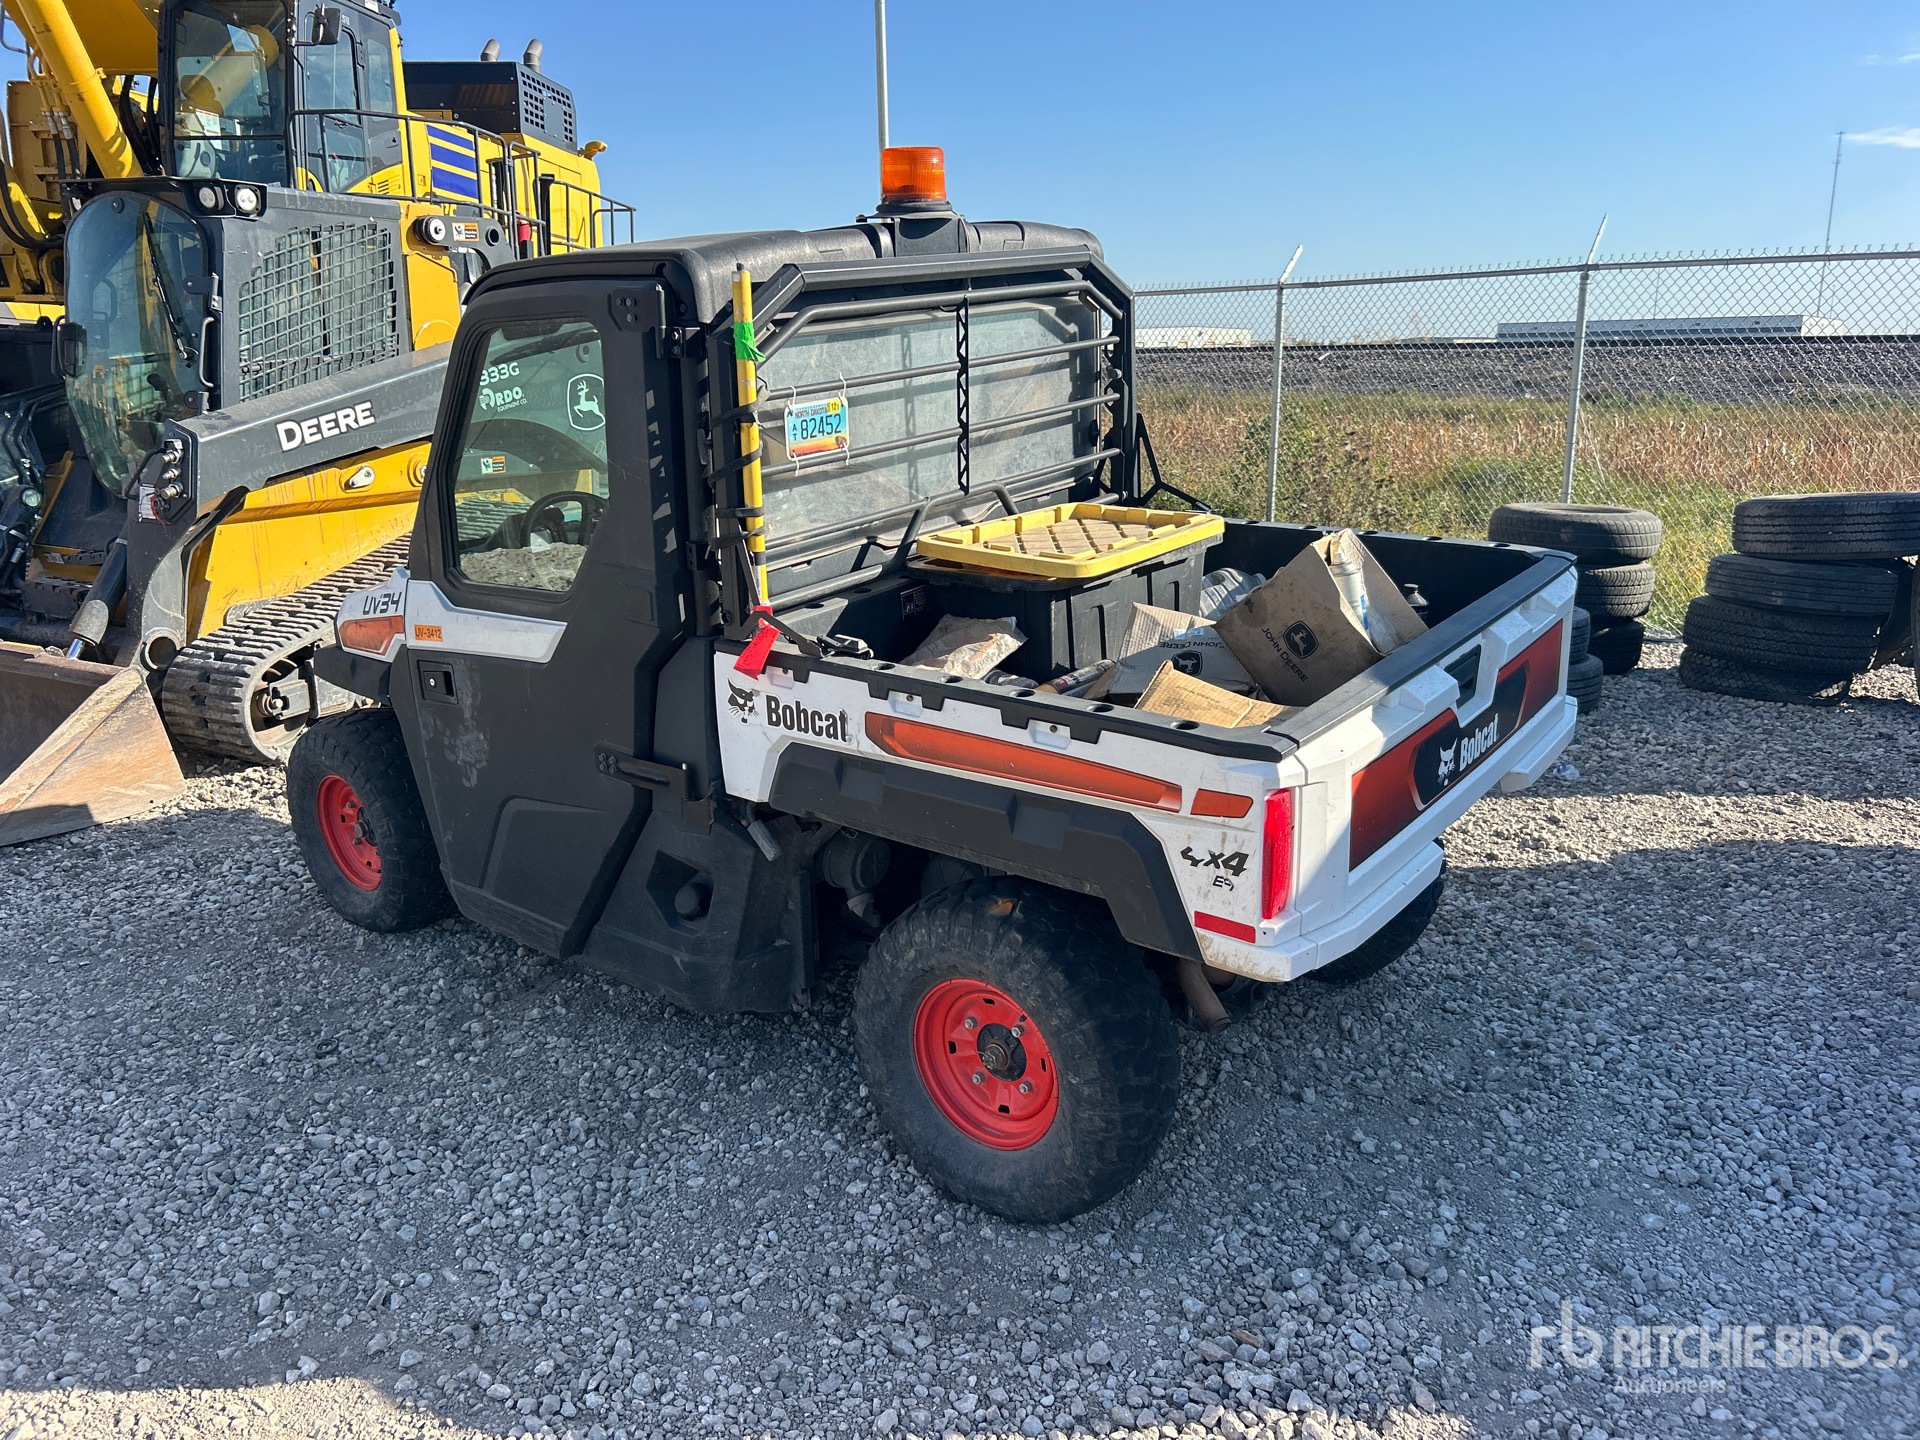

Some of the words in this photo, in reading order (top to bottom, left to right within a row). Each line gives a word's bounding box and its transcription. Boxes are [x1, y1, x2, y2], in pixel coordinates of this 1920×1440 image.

[495, 386, 522, 406] RDO
[276, 401, 376, 452] DEERE
[795, 409, 810, 419] NORTH
[800, 413, 842, 440] 82452
[363, 592, 402, 615] UV34
[415, 628, 442, 639] UV-3412
[1260, 627, 1282, 652] JOHN
[1280, 651, 1308, 682] DEERE
[765, 694, 848, 743] Bobcat
[1459, 712, 1499, 771] Bobcat
